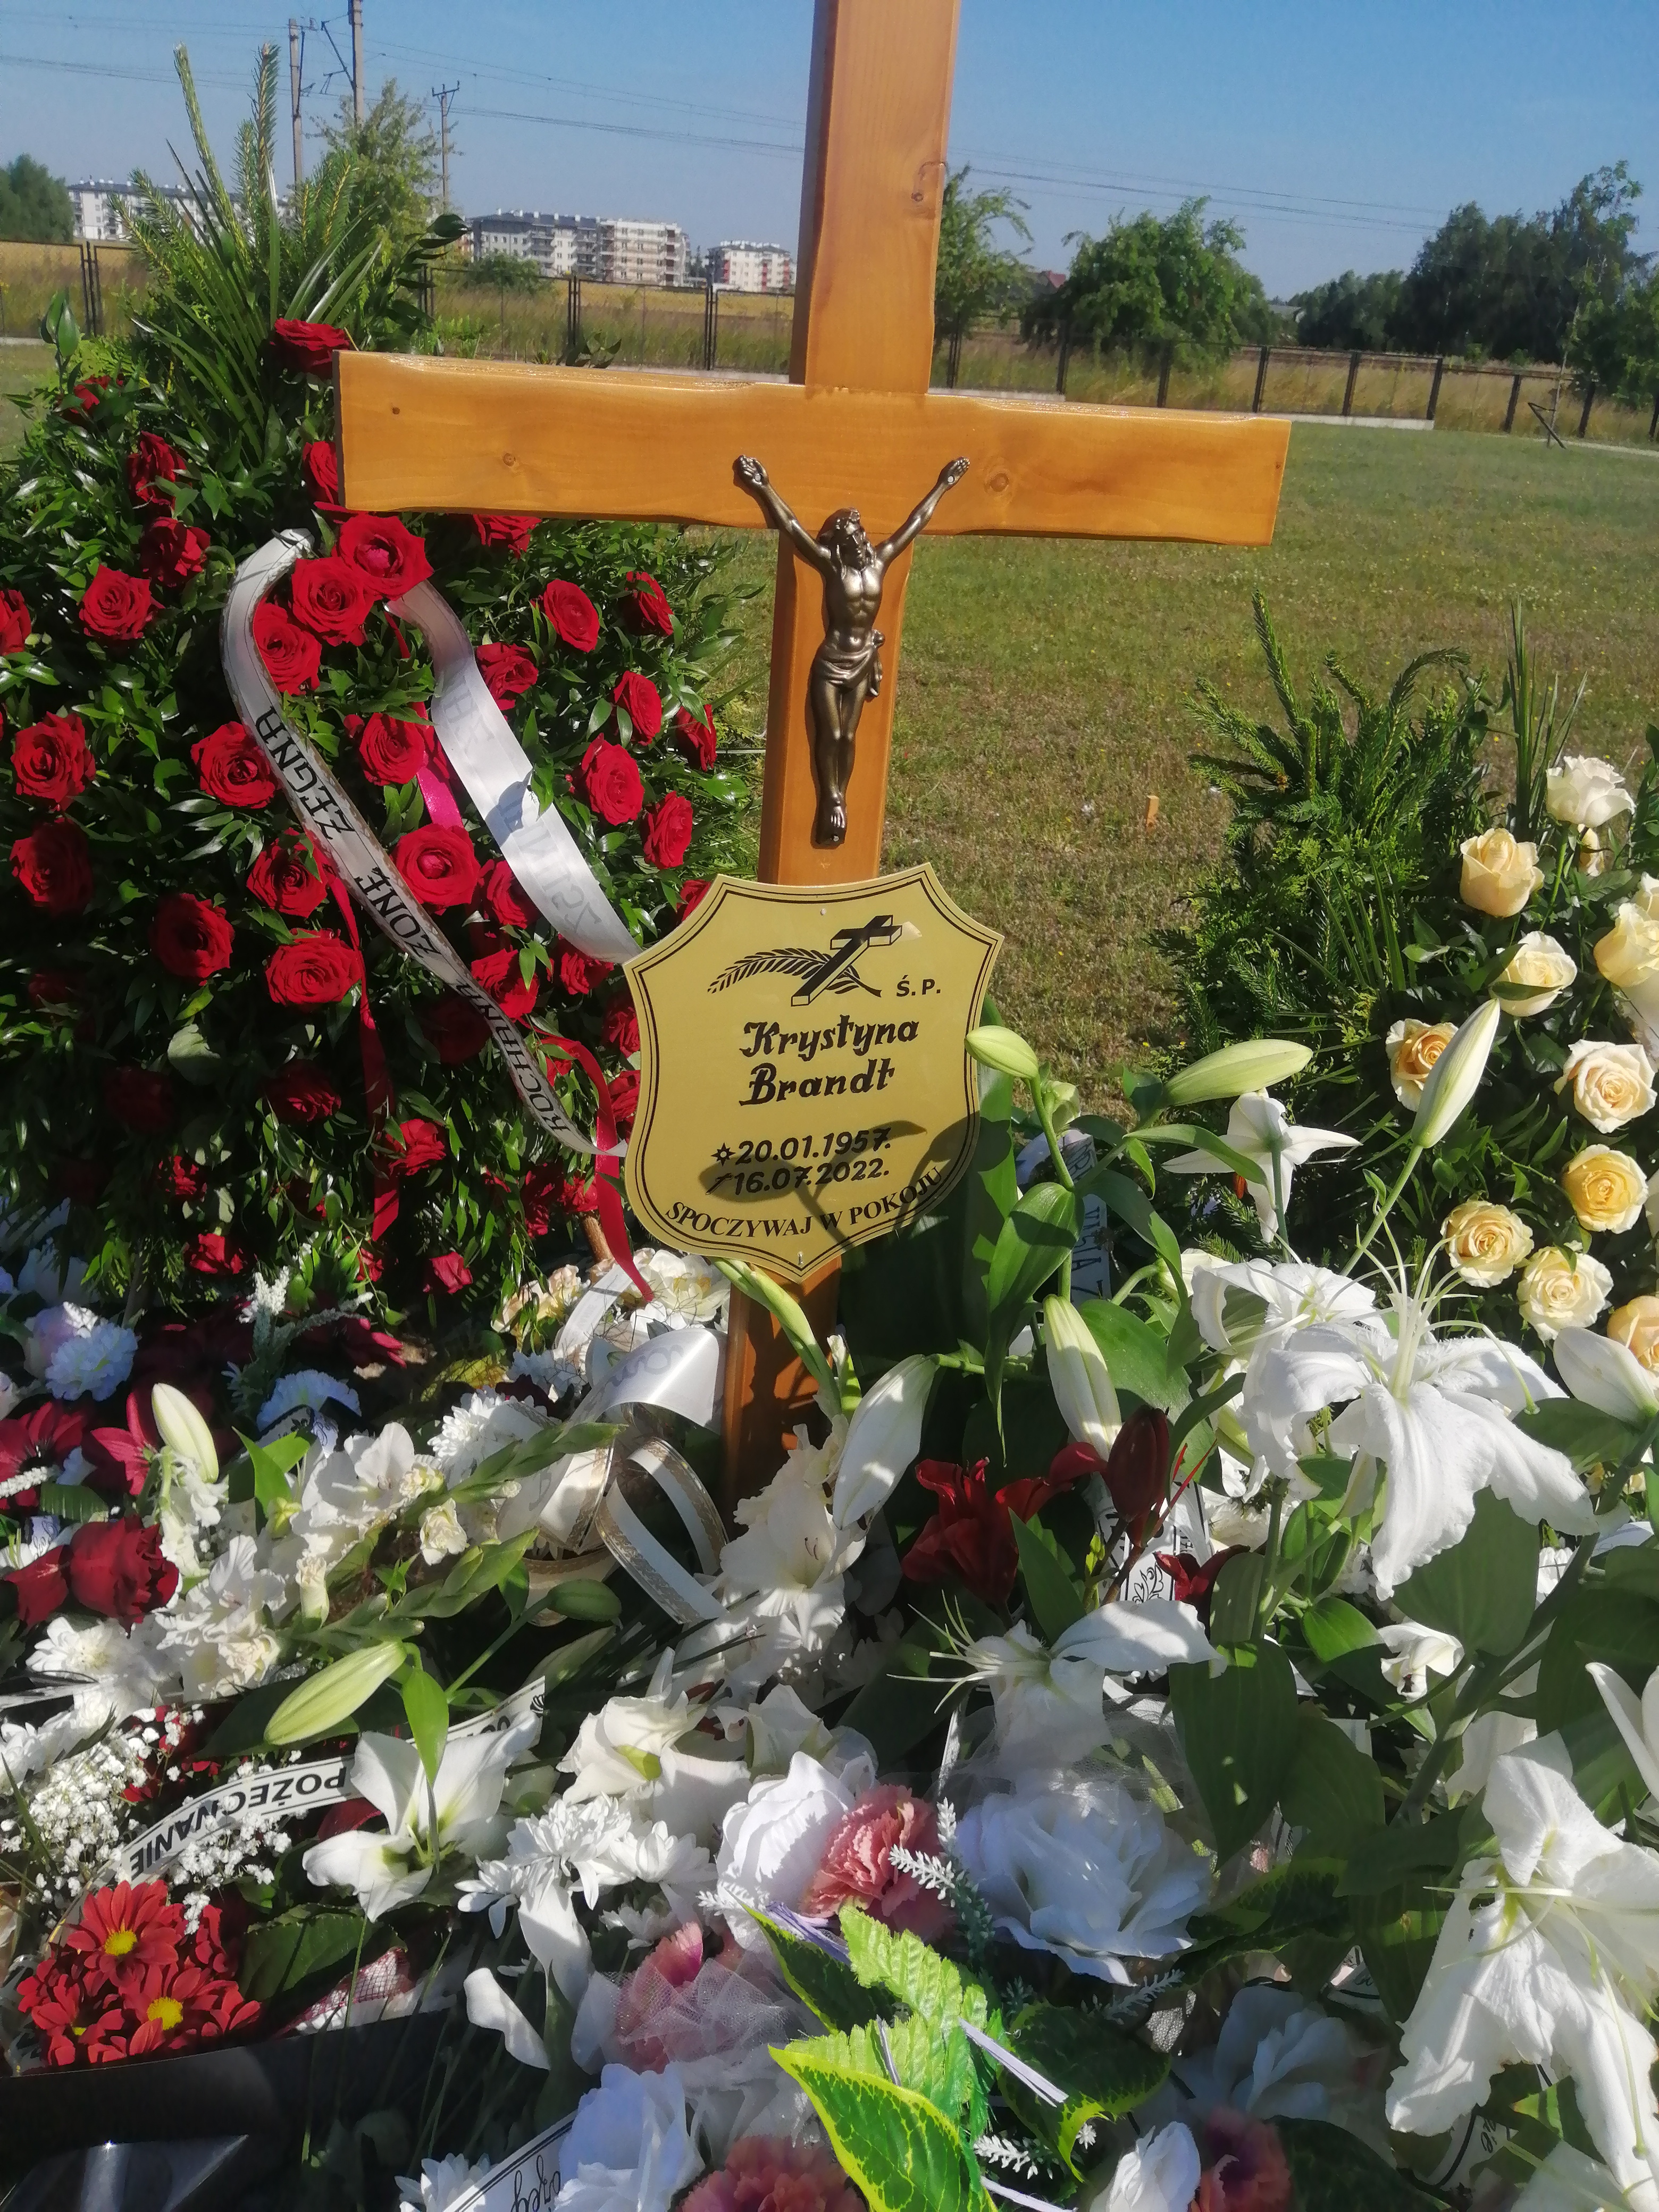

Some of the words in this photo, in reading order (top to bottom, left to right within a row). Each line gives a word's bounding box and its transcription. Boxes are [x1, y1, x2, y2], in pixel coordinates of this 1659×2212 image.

[739, 1014, 919, 1061] Krystyna
[739, 1058, 895, 1106] Brandt
[734, 1158, 890, 1195] 16.07.2022.
[665, 1202, 813, 1237] SPOCZYWAJ
[819, 1210, 843, 1231] W
[849, 1167, 943, 1225] POKOJU
